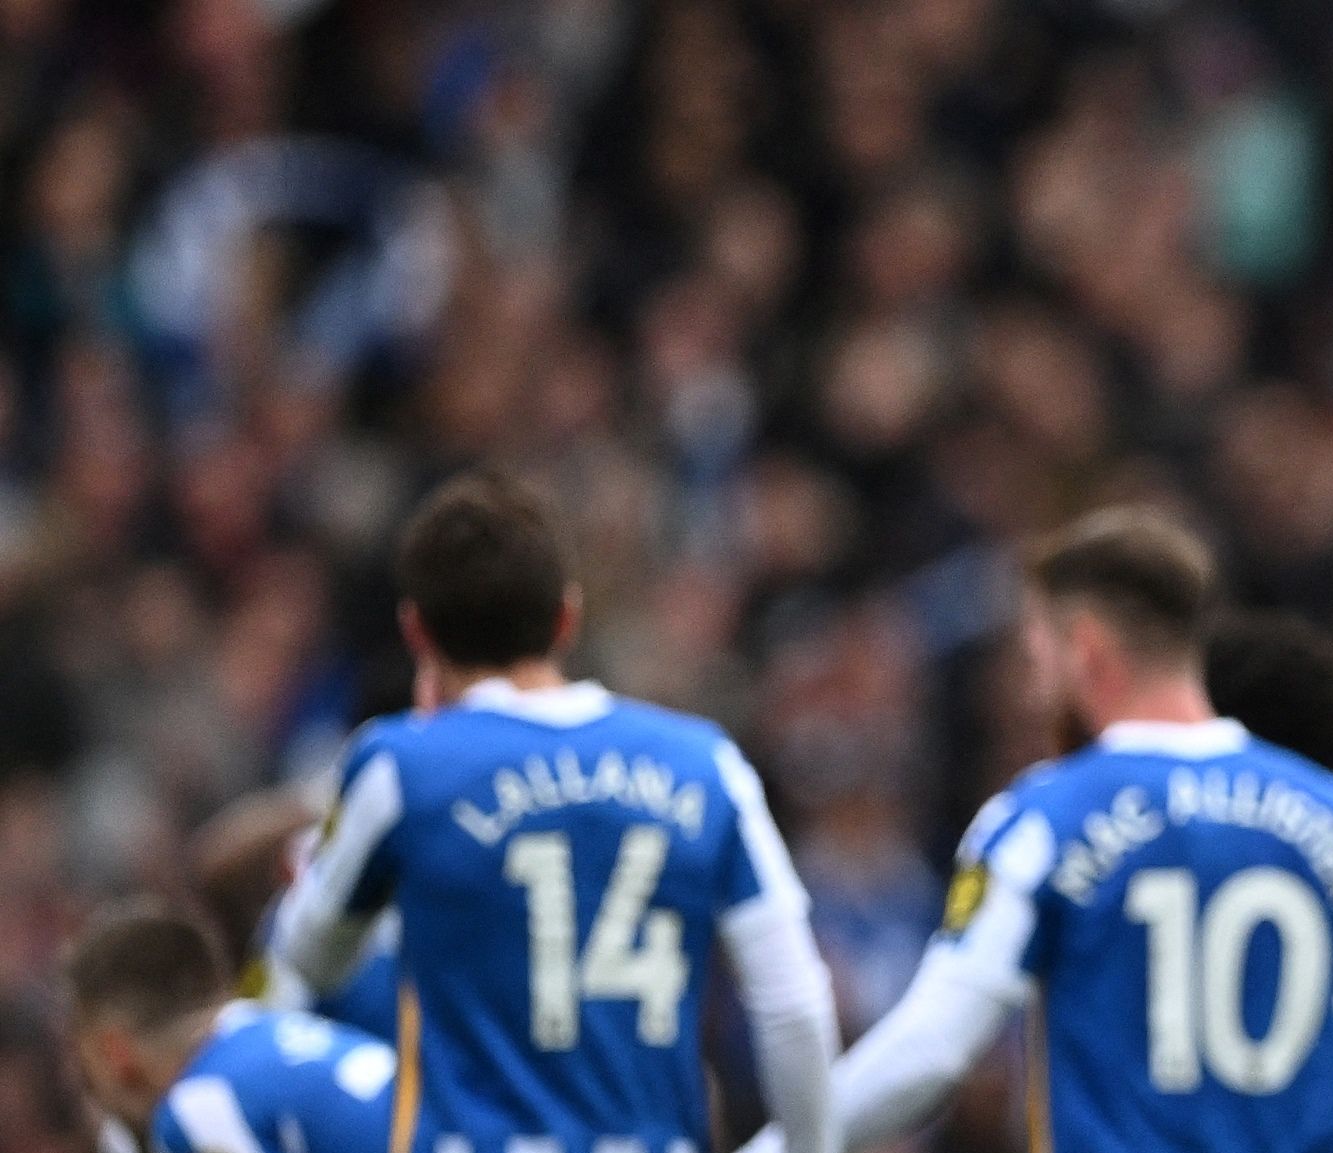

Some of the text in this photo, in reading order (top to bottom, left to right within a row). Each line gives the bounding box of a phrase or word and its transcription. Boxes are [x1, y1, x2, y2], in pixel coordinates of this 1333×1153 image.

[452, 746, 706, 845] LALLANA
[1053, 784, 1166, 908] MAC
[502, 824, 690, 1050] 14
[1123, 864, 1333, 1096] 10
